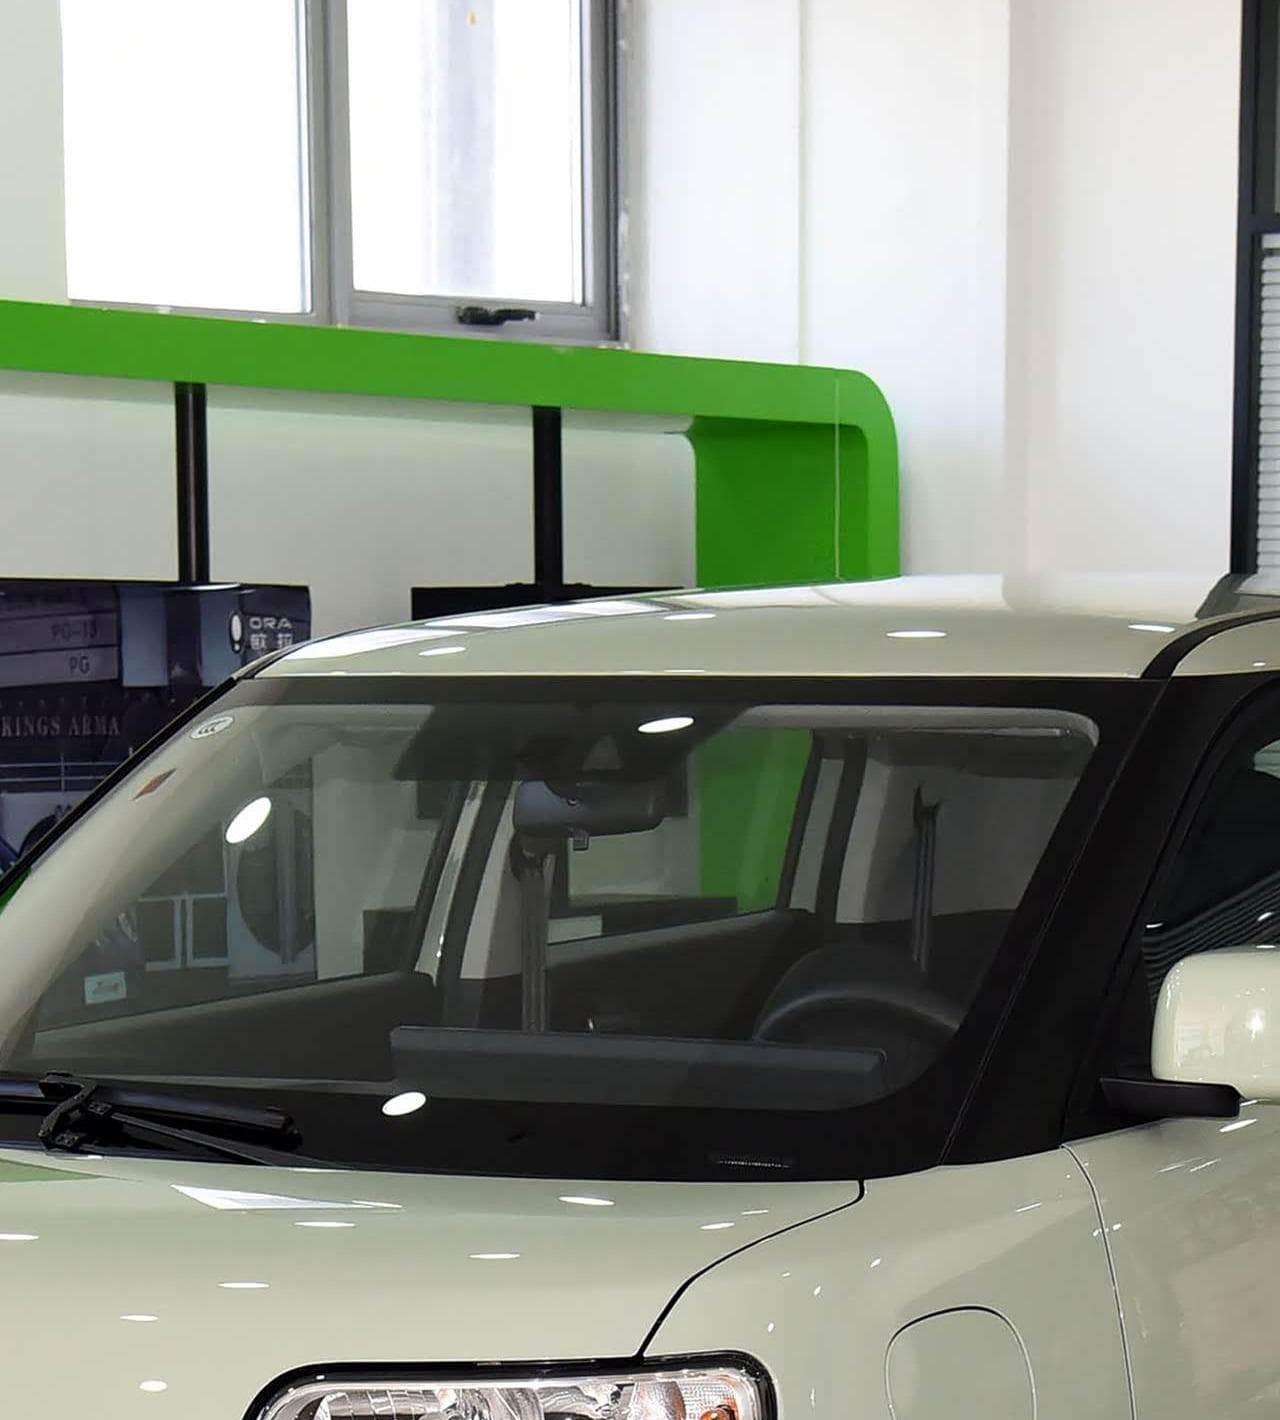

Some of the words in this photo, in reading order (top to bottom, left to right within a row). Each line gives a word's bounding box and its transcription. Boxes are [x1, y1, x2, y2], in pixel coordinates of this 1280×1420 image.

[249, 617, 292, 629] ORA
[70, 656, 90, 674] PG
[1, 715, 60, 738] KINGS
